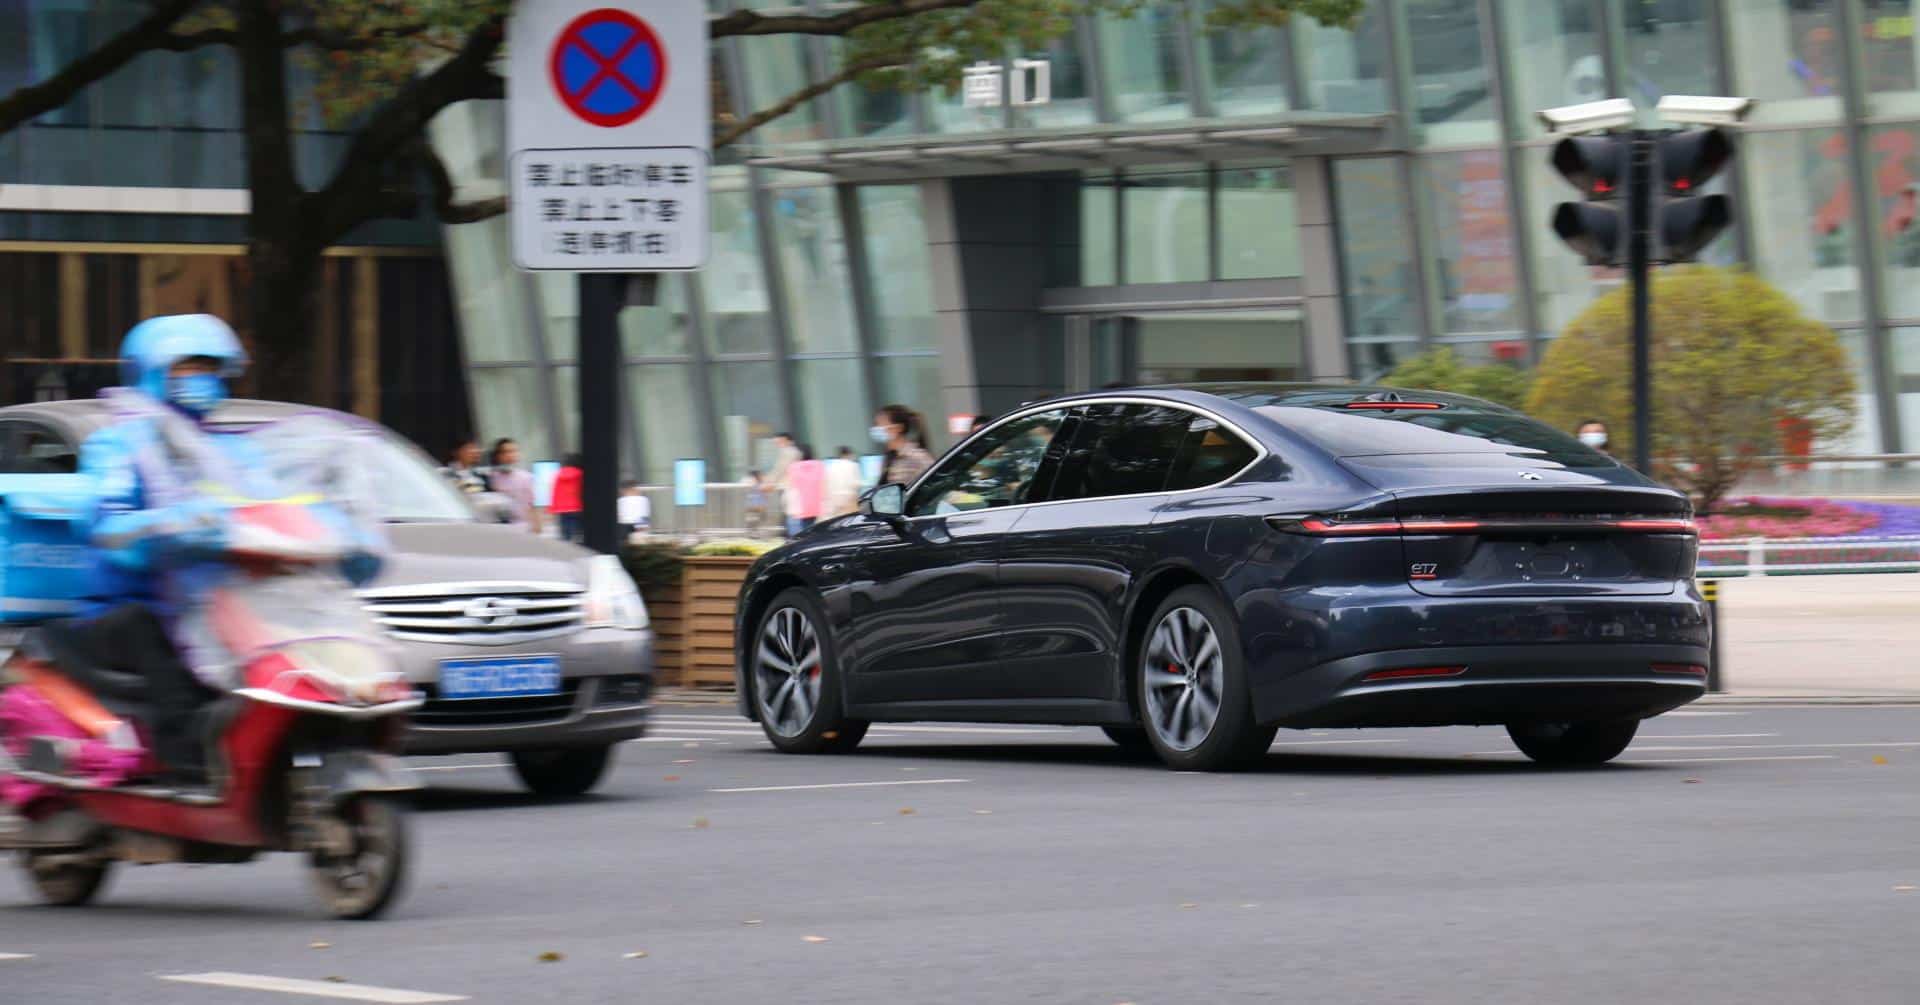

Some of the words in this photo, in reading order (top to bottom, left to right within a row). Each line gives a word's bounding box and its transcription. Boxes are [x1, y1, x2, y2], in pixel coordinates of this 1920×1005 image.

[962, 59, 1050, 106] 南门
[528, 163, 694, 187] 禁止临时停车
[541, 198, 682, 222] 禁止上下客
